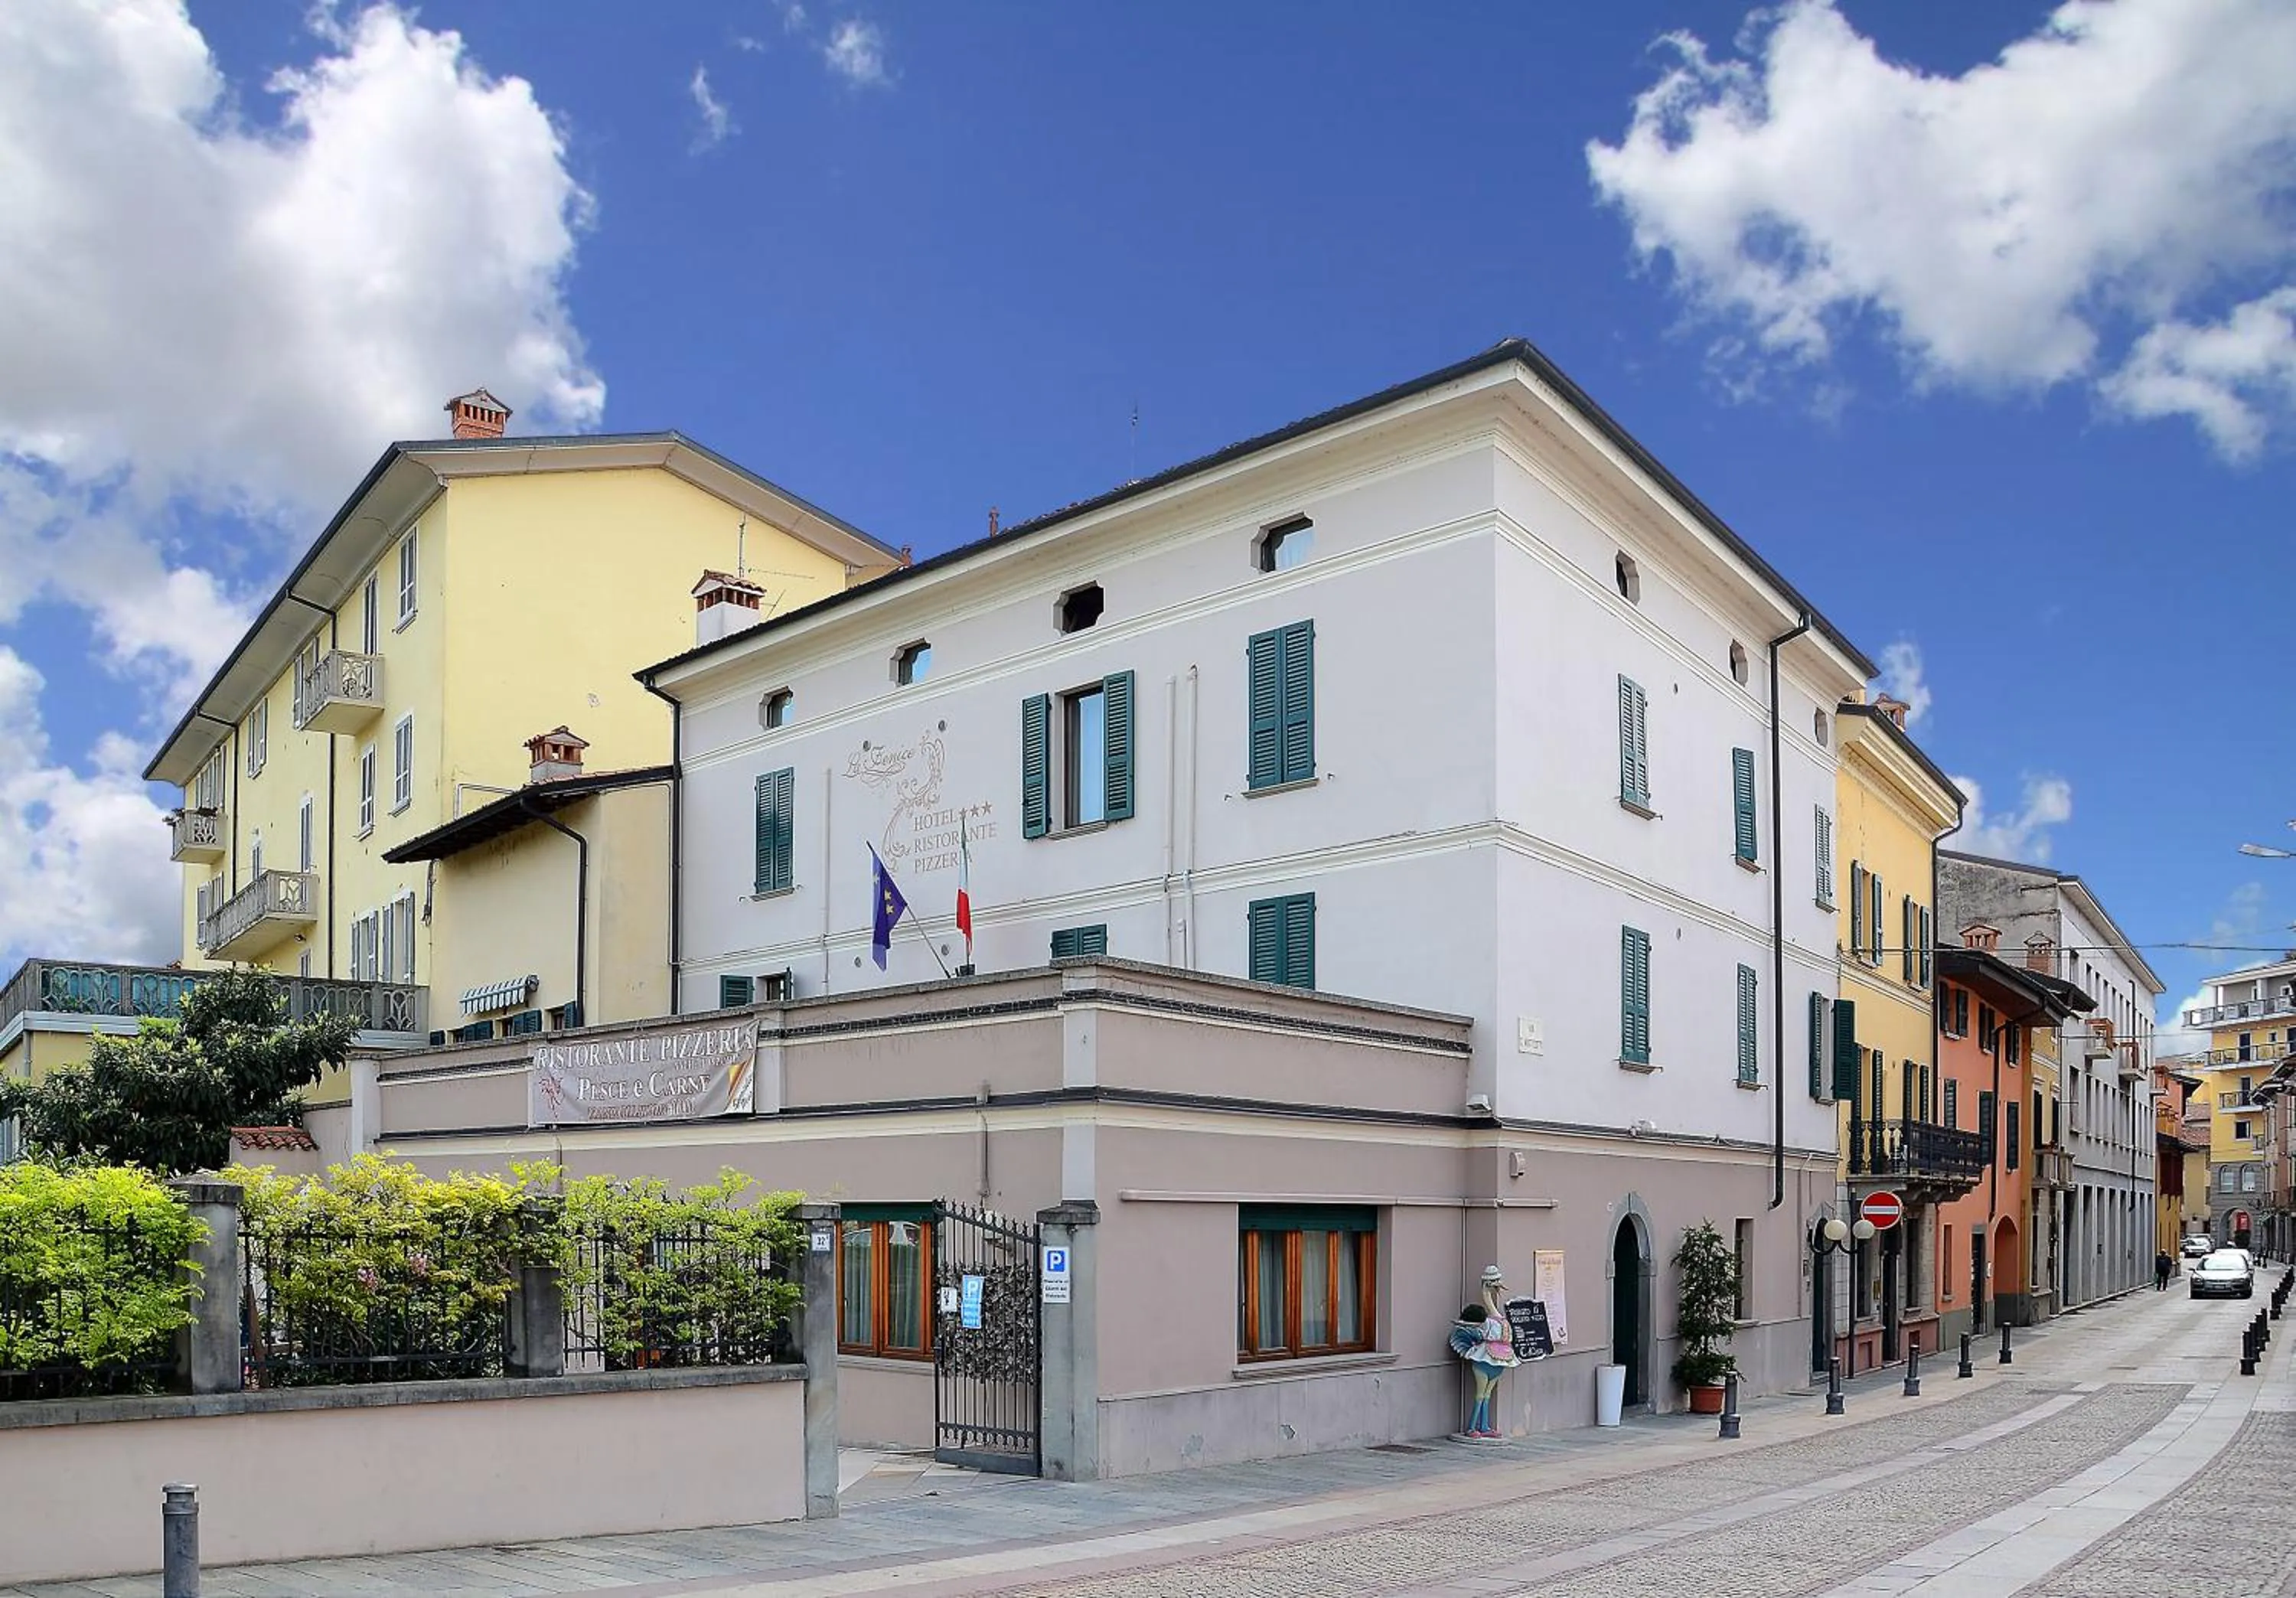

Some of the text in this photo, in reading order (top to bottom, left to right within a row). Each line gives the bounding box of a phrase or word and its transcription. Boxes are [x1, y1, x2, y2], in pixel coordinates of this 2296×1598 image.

[914, 808, 957, 832] HOTEL
[914, 822, 997, 853] RISTORNTE
[536, 1039, 650, 1069] RISTORANTE
[660, 1026, 754, 1060] PIZZERIA
[1049, 1252, 1062, 1270] P
